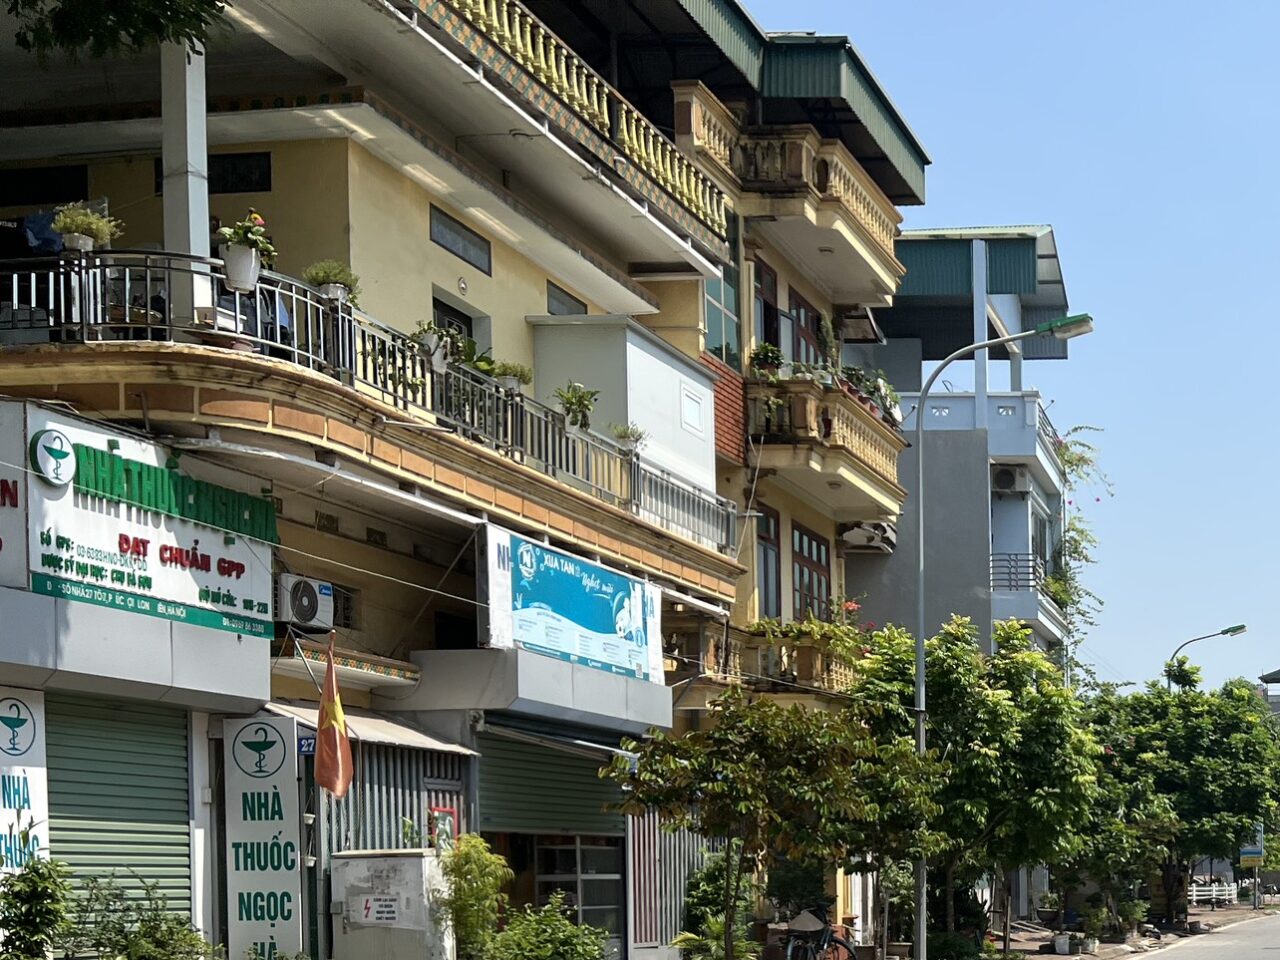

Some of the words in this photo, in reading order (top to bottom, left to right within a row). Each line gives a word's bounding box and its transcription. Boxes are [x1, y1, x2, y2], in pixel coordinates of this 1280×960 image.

[216, 557, 246, 579] GPP
[1, 768, 31, 810] NHÀ
[242, 785, 284, 821] NHÀ
[232, 830, 296, 872] THUỐC
[238, 891, 293, 928] NGỌC
